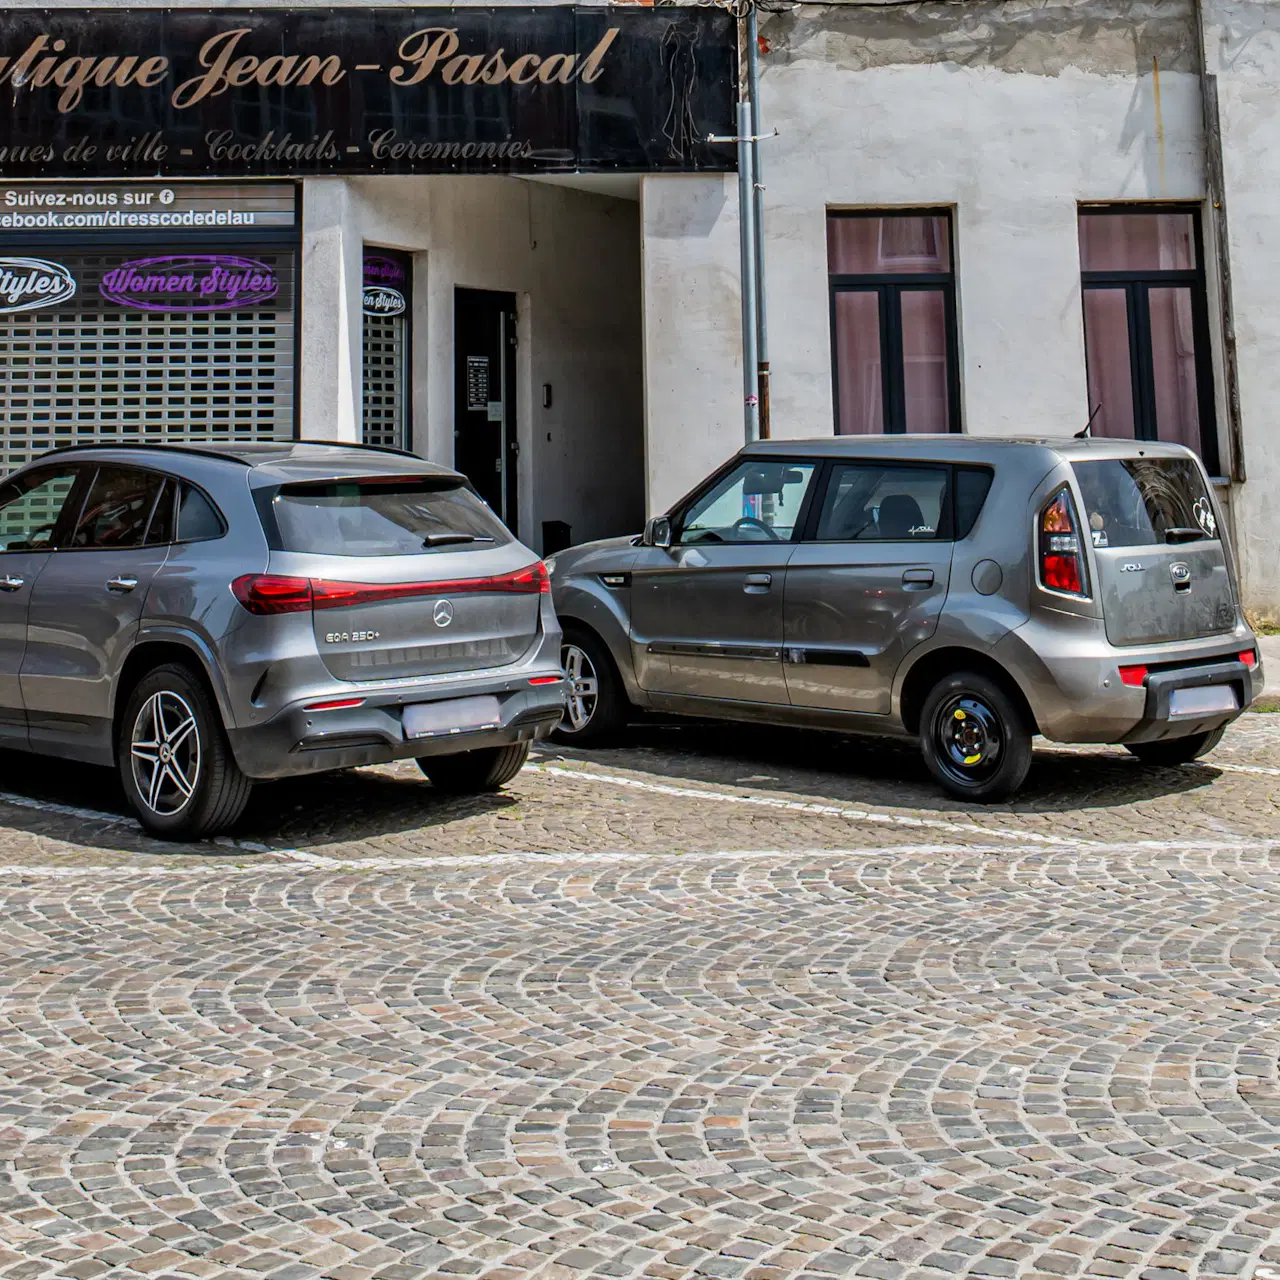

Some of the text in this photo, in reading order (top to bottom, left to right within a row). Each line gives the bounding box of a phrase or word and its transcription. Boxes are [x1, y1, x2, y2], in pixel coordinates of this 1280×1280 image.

[170, 28, 346, 110] Jean
[389, 26, 620, 86] Pascal
[63, 135, 89, 162] de
[106, 130, 168, 162] ville
[205, 129, 338, 162] Cocktails
[4, 190, 118, 207] Suivez-nous
[123, 193, 154, 206] sur
[106, 265, 275, 301] Women Styles
[364, 292, 403, 312] en Styles
[325, 630, 380, 643] EQA 250+
